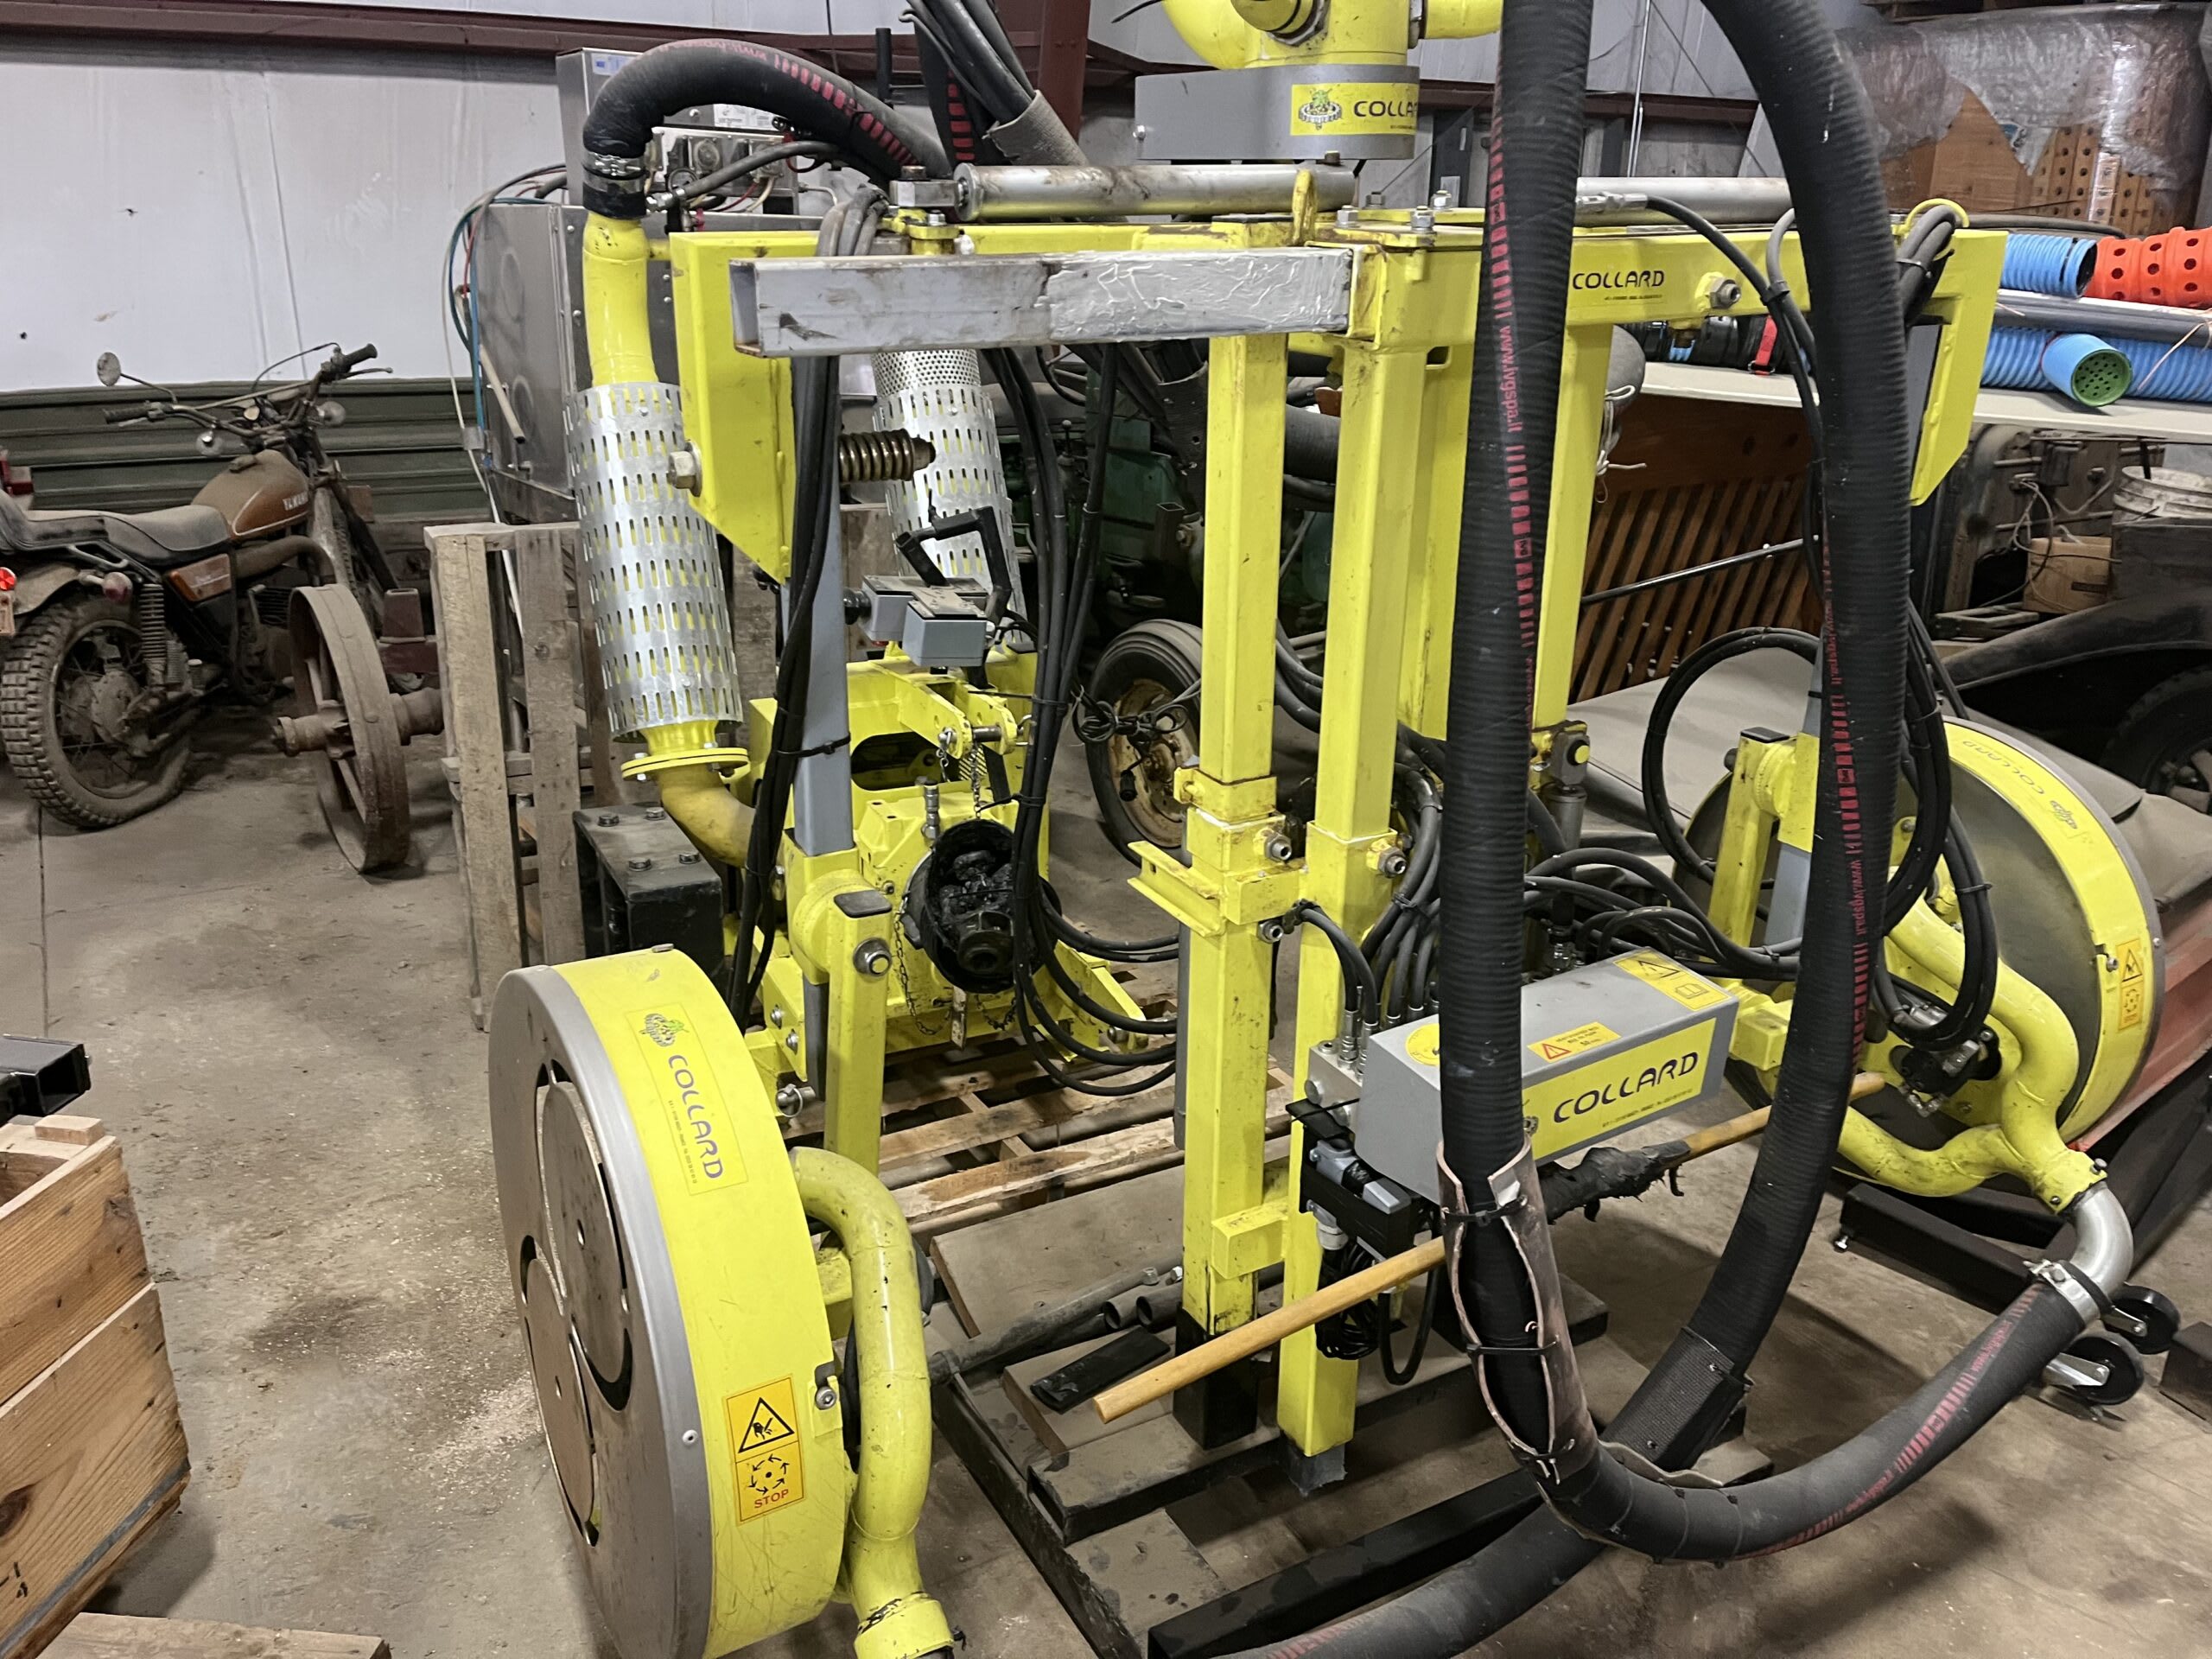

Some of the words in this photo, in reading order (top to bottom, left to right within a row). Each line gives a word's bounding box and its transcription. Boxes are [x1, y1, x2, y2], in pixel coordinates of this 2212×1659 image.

[1353, 100, 1417, 118] COLLA
[1572, 270, 1665, 290] COLLARD
[1961, 741, 2045, 795] COLLARD
[1553, 1051, 1699, 1124] COLLARD
[668, 1053, 724, 1179] COLLARD
[753, 1488, 790, 1510] STOP
